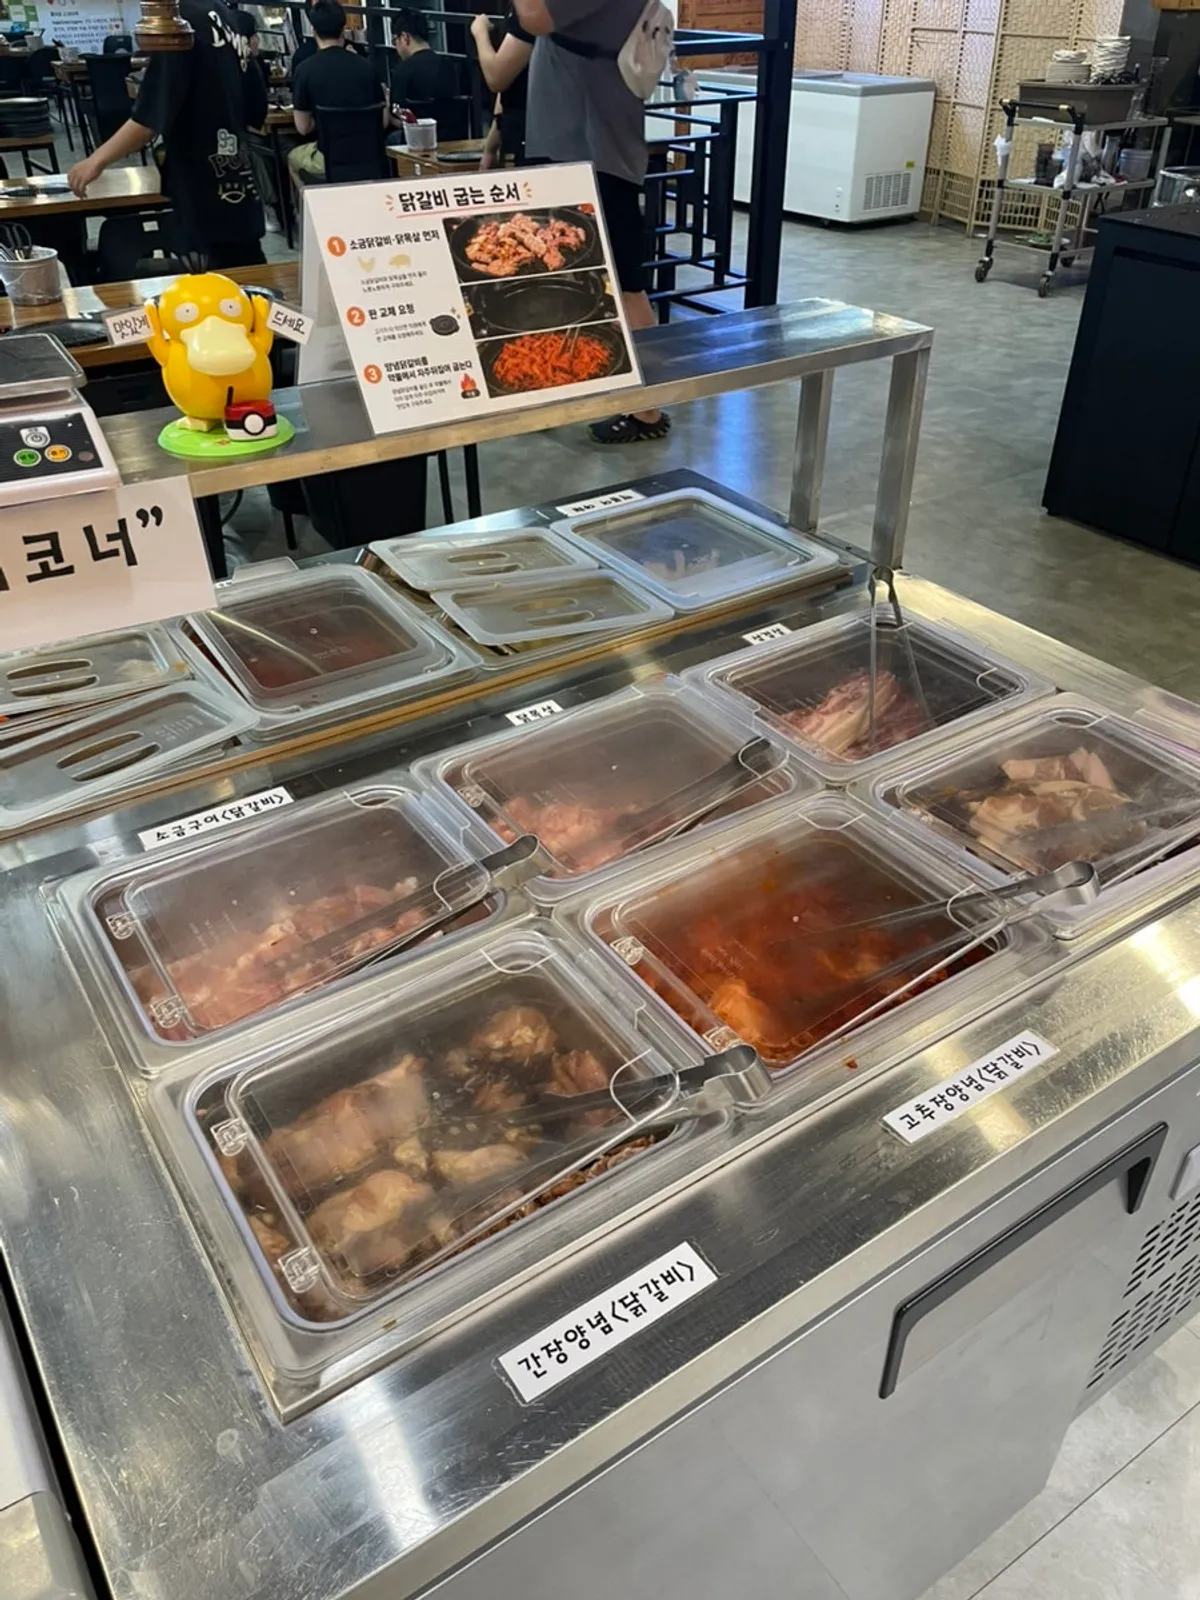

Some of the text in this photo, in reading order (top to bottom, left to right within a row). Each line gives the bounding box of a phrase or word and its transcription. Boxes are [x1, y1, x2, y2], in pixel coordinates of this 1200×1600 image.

[399, 183, 521, 212] 닭갈비 굽는 순서
[423, 229, 441, 242] 먼저
[272, 310, 306, 335] 드세요
[368, 309, 378, 321] 판
[380, 305, 397, 319] 교체
[398, 303, 415, 316] 요청
[384, 356, 429, 373] 양념닭갈비를
[0, 505, 163, 592] 코너”
[898, 1039, 1043, 1131] 고추장양념<닭갈비>
[516, 1260, 696, 1378] 간장양념<닭갈비>
